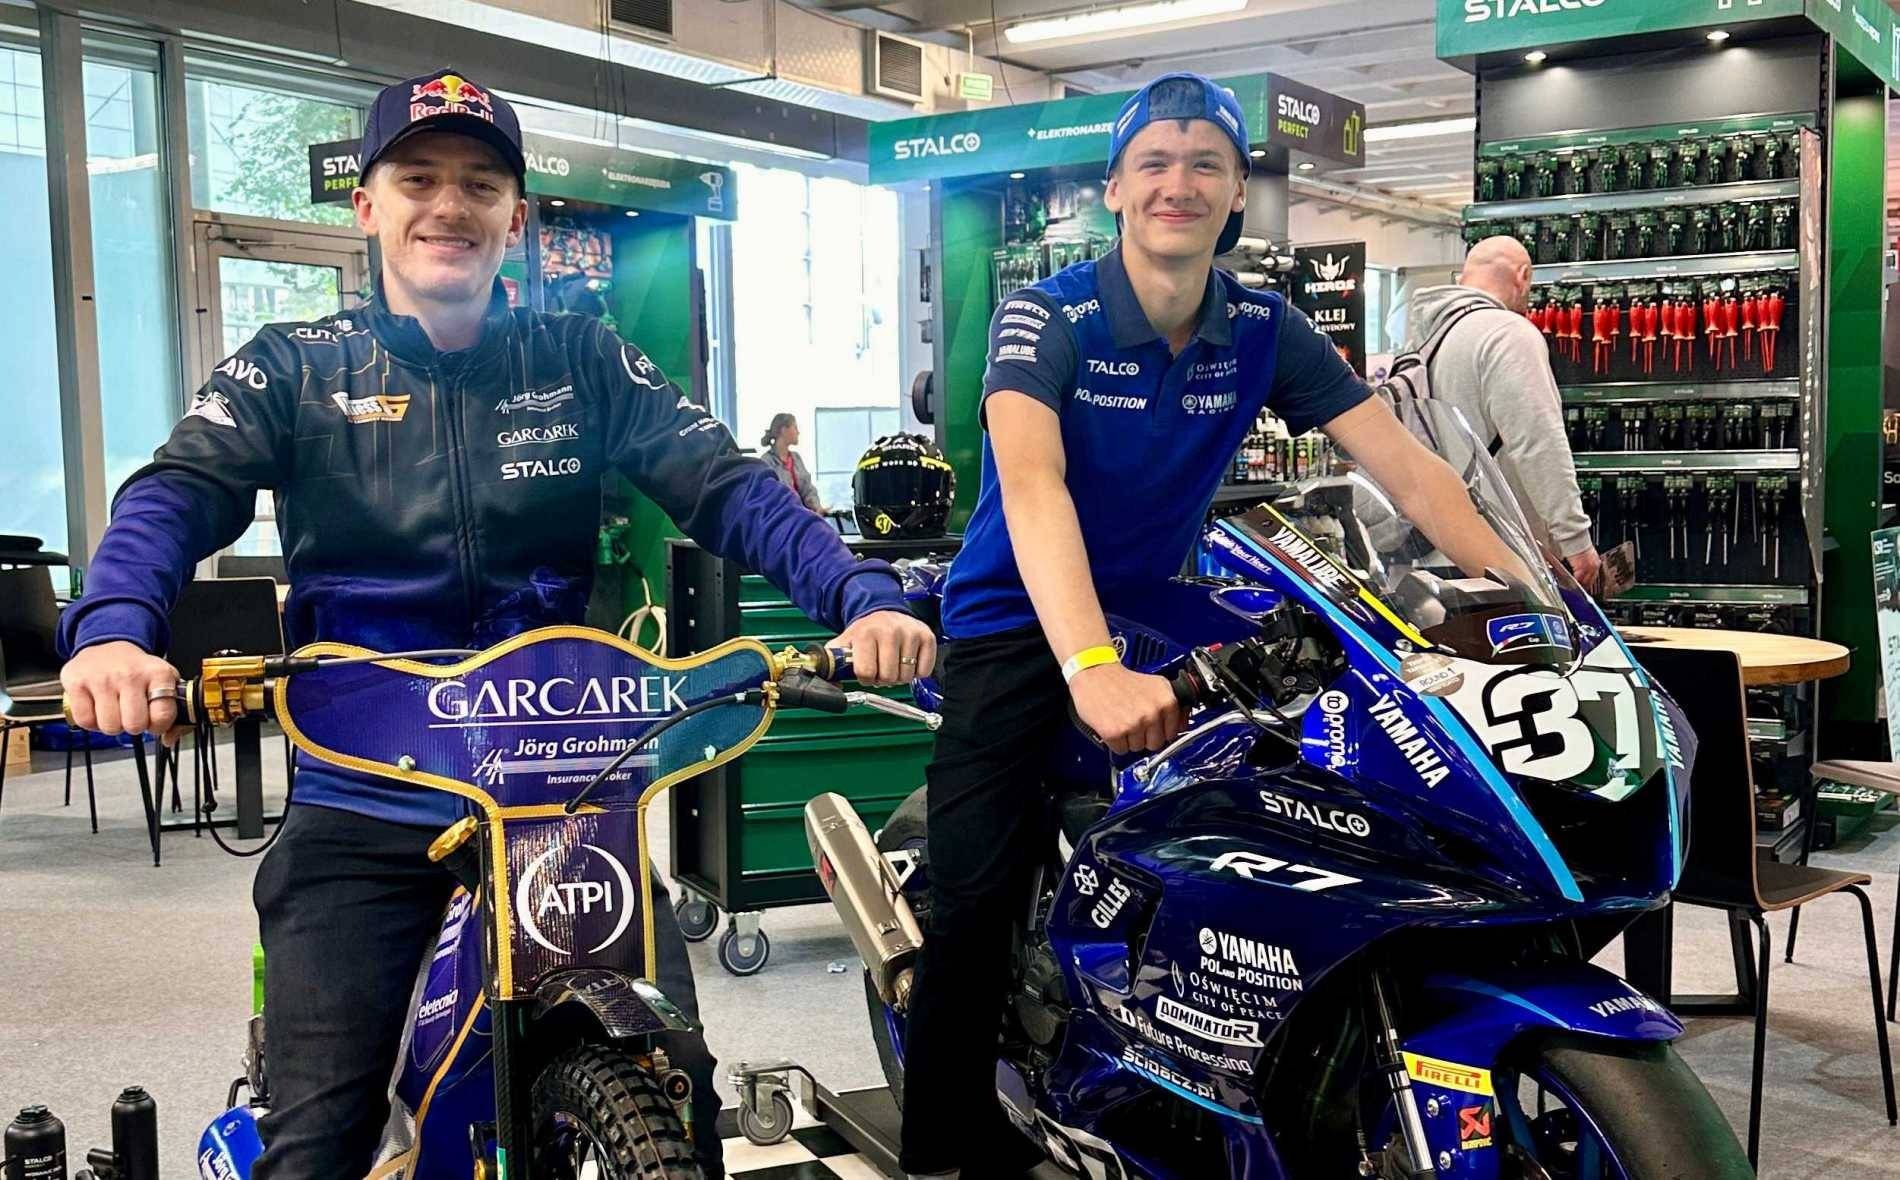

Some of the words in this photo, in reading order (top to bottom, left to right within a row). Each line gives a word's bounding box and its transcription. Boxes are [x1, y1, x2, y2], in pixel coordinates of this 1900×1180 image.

[1278, 94, 1320, 125] STALCO
[1278, 118, 1309, 139] PERFECT
[894, 132, 981, 160] STALCO
[322, 153, 361, 176] STA
[1315, 308, 1346, 322] KLEJ
[1085, 359, 1140, 376] TALCO
[501, 457, 581, 480] STALCO
[1268, 526, 1350, 588] YAMALUBE
[427, 676, 689, 719] GARCAREK
[1482, 664, 1641, 782] 37
[514, 737, 557, 760] Jörg
[1368, 693, 1450, 789] YAMAHA
[547, 773, 597, 784] Insurance
[1259, 790, 1370, 837] STALCO
[1209, 851, 1364, 892] R7
[538, 881, 613, 918] ATPI
[1091, 876, 1132, 929] GILLES
[1218, 931, 1300, 976] YAMAHA
[1189, 971, 1278, 1009] OŚWIĘCIM
[1237, 970, 1304, 991] POSITION
[1160, 1001, 1257, 1041] DOMINATOR
[1192, 991, 1216, 1009] CITY
[1221, 1002, 1236, 1014] OF
[1241, 1006, 1285, 1021] PEACE
[1137, 1016, 1174, 1051] Future
[1176, 1034, 1255, 1076] Processing
[1416, 1060, 1482, 1089] PIRELLI
